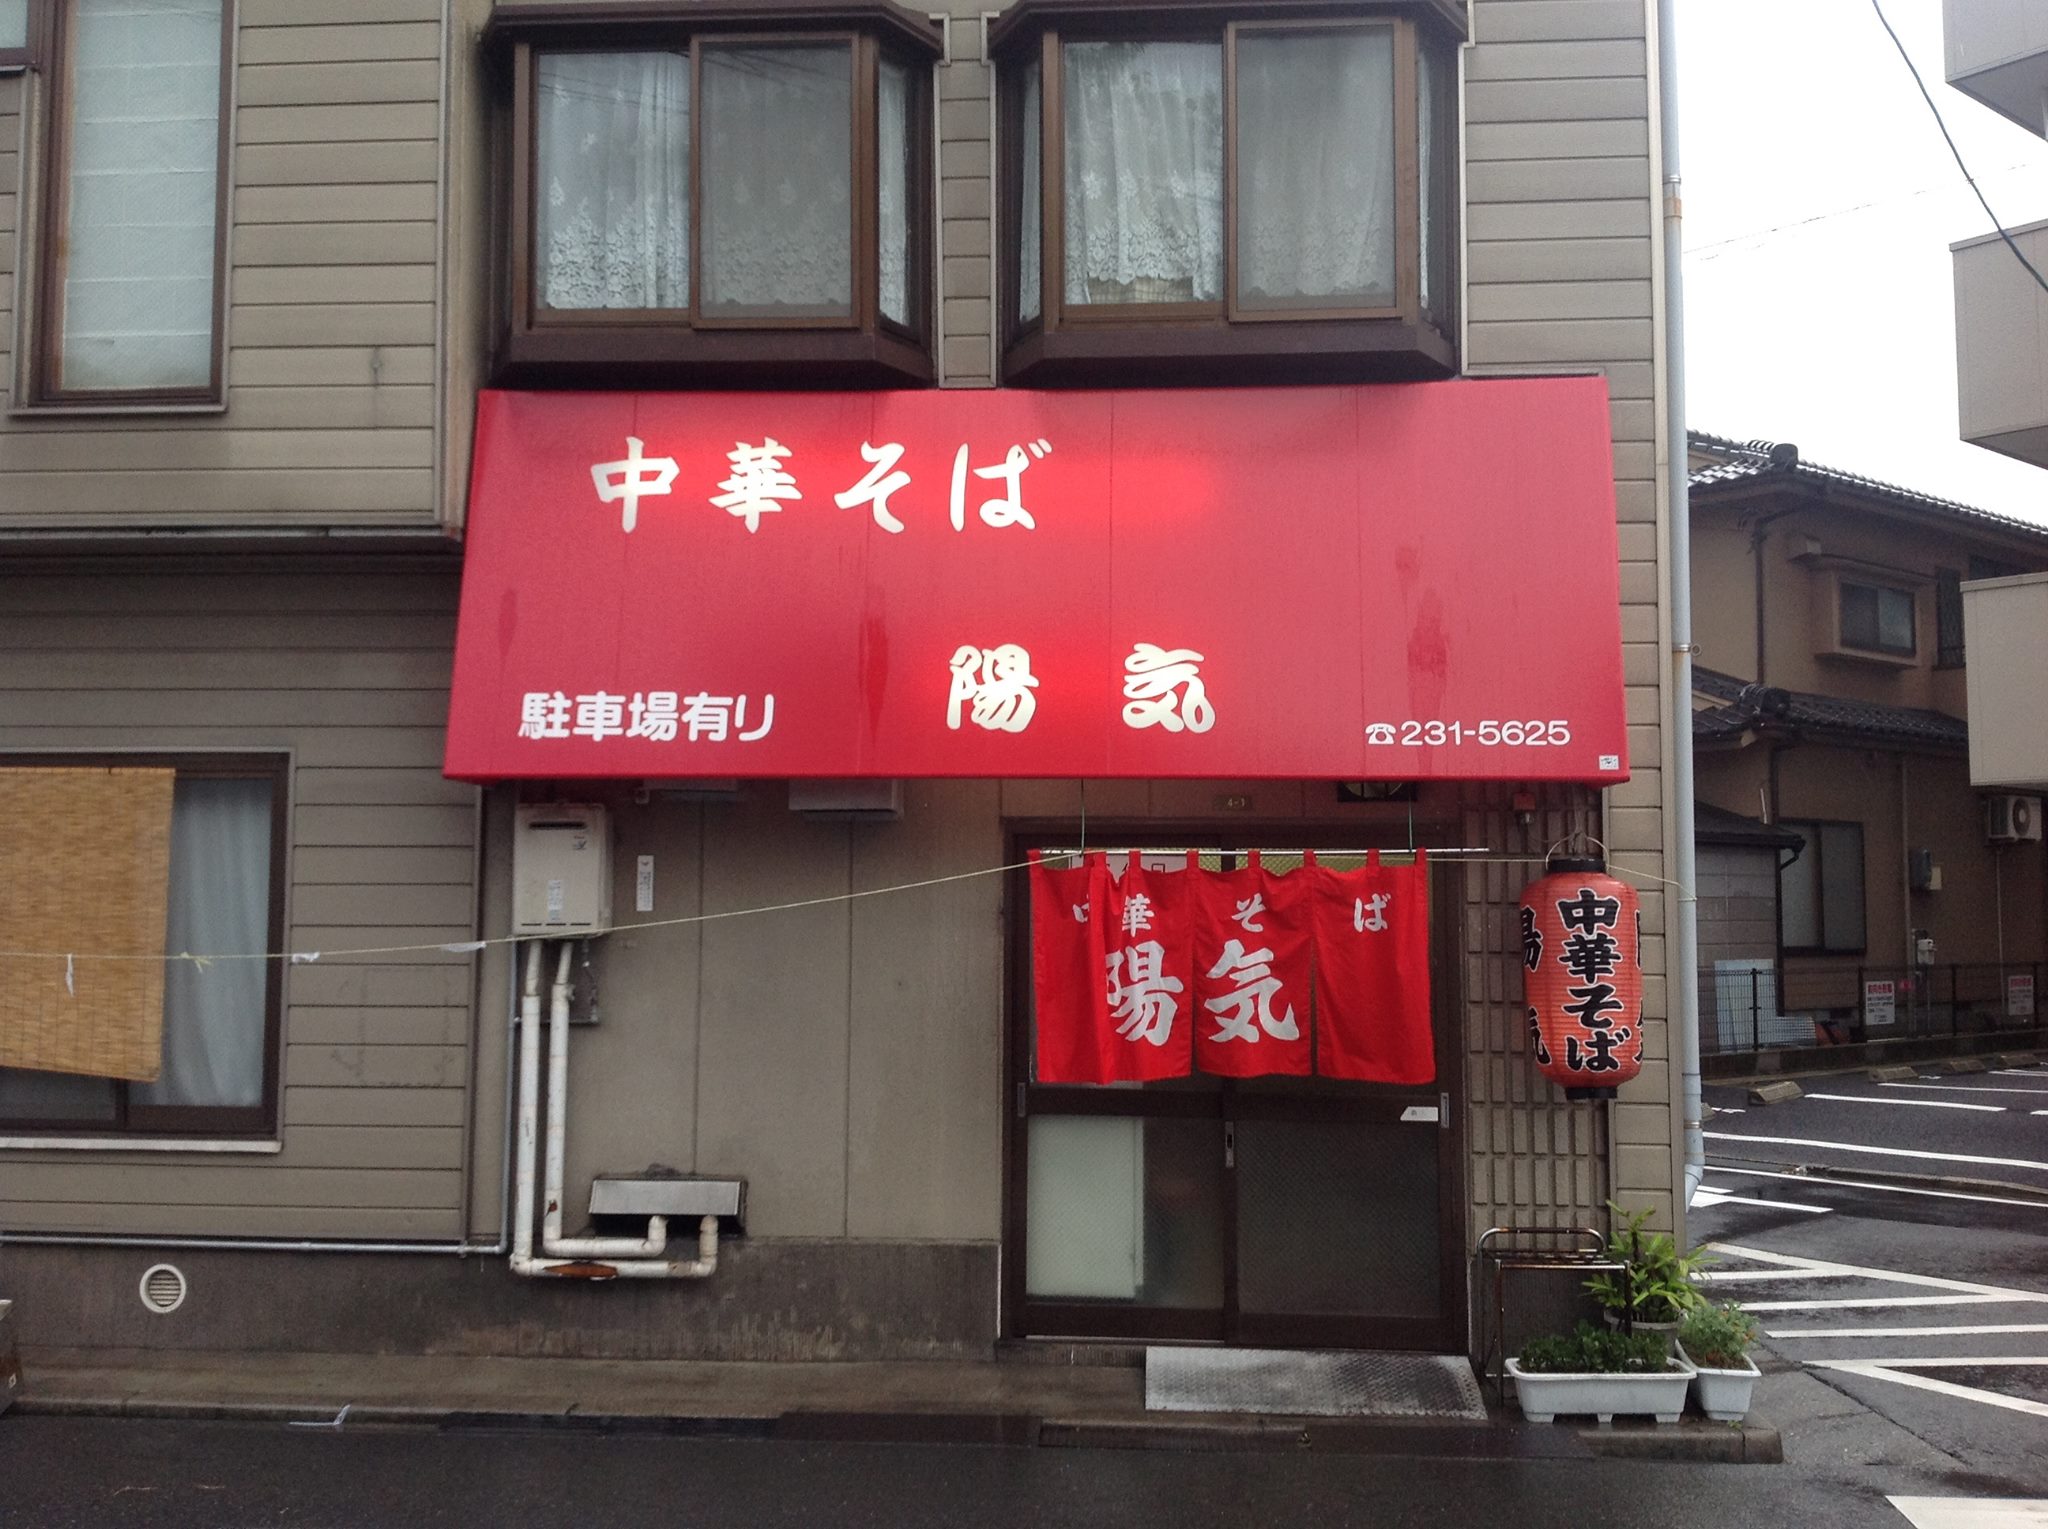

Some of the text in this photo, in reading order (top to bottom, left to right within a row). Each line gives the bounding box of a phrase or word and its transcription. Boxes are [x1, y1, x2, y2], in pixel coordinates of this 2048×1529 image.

[590, 436, 1052, 534] 中華そば
[947, 643, 1216, 733] 陽気
[1401, 719, 1571, 746] 231-5625
[1106, 938, 1300, 1047] 陽気
[1555, 888, 1631, 1073] 中華そば
